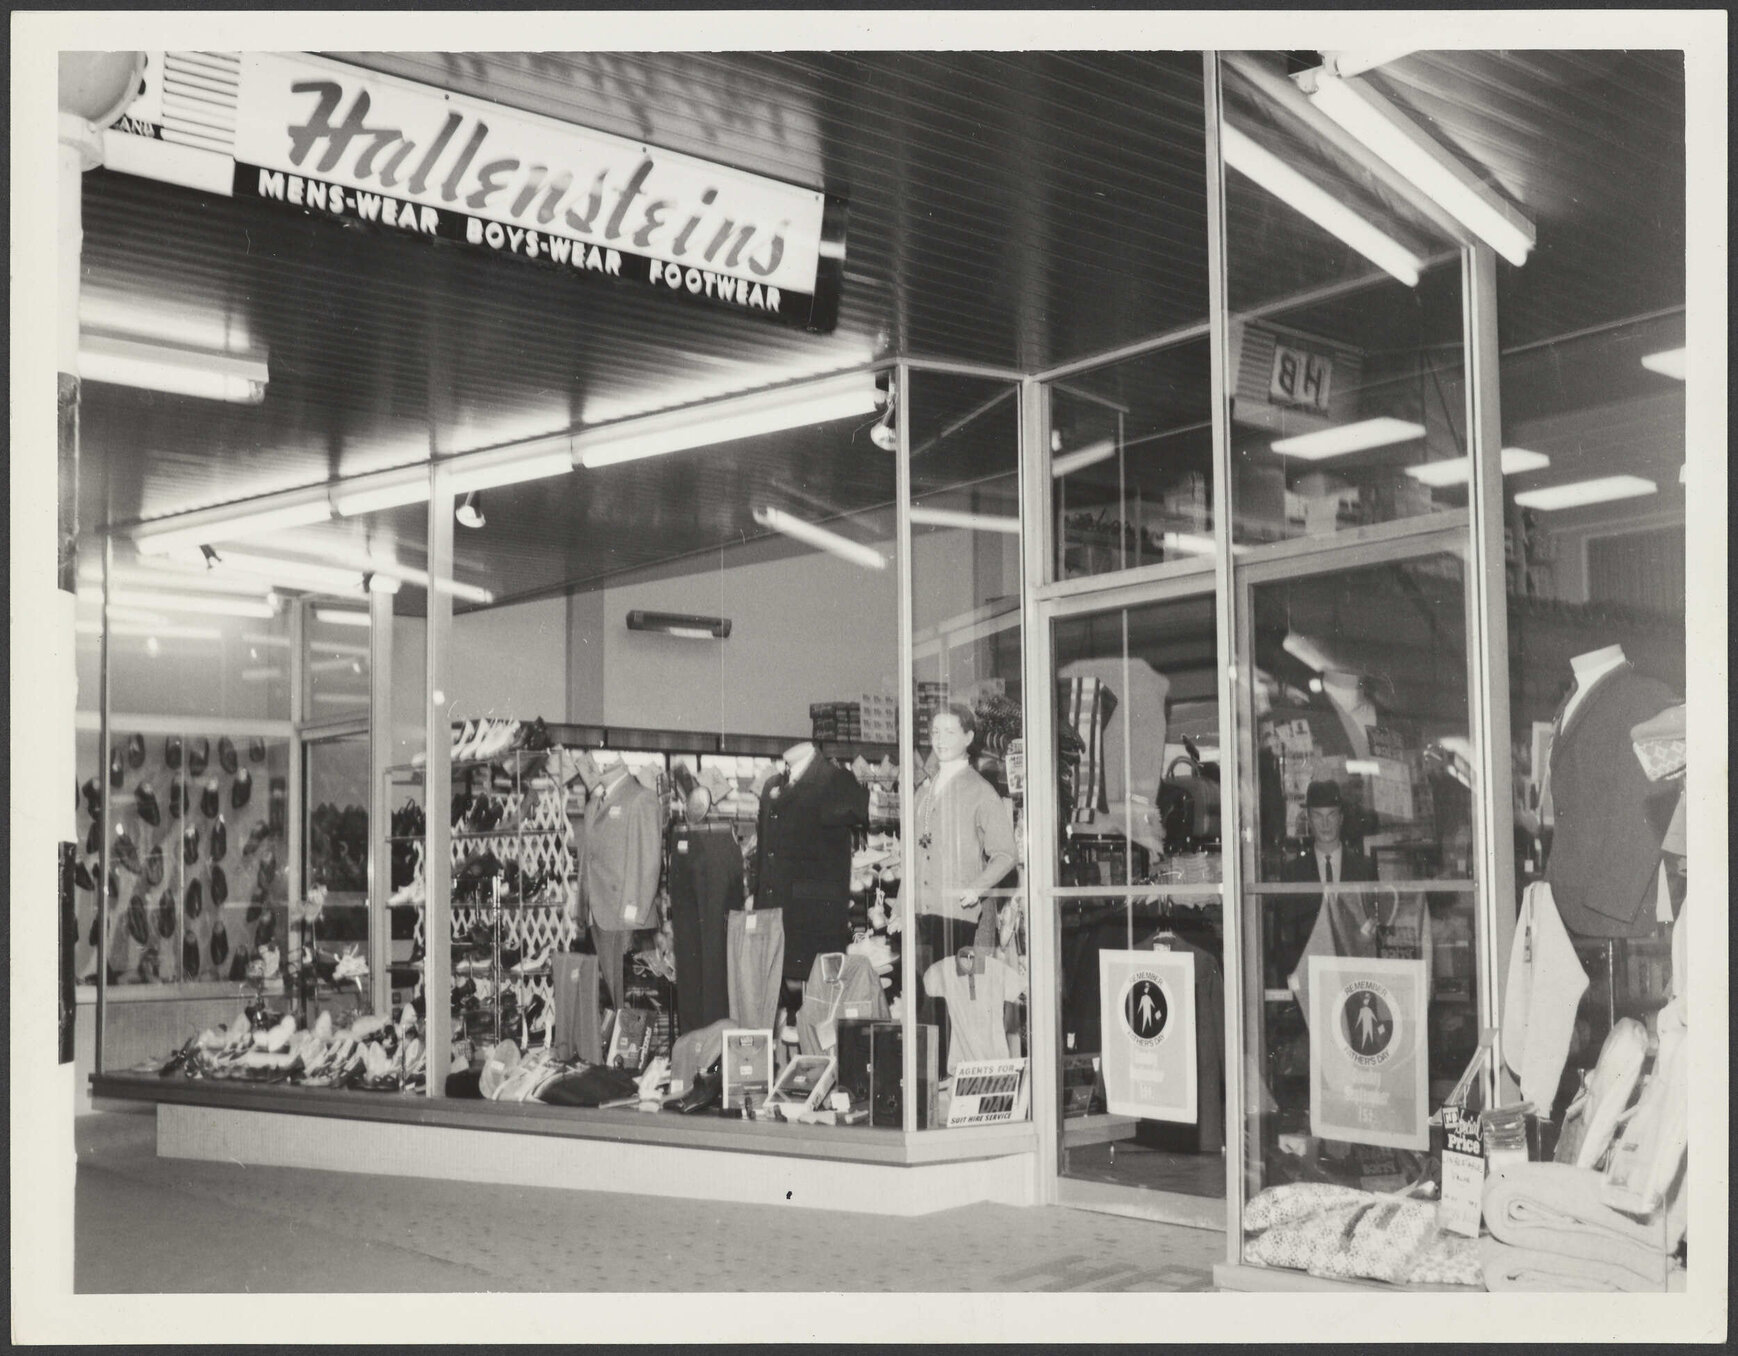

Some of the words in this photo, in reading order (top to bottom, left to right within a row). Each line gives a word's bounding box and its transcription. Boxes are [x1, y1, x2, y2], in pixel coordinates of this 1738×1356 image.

[287, 80, 791, 276] Hallensteins
[257, 168, 440, 235] MENS-WEAR
[465, 216, 622, 277] BOYS-WEAR
[648, 258, 781, 313] FOOTWEAR
[959, 1066, 994, 1076] AGENTS
[998, 1064, 1015, 1073] FOR
[980, 1095, 1014, 1114] DAY
[950, 1116, 967, 1124] SUIT
[968, 1114, 984, 1122] HIRE
[985, 1112, 1012, 1121] SERVICE
[1447, 1133, 1480, 1155] Price
